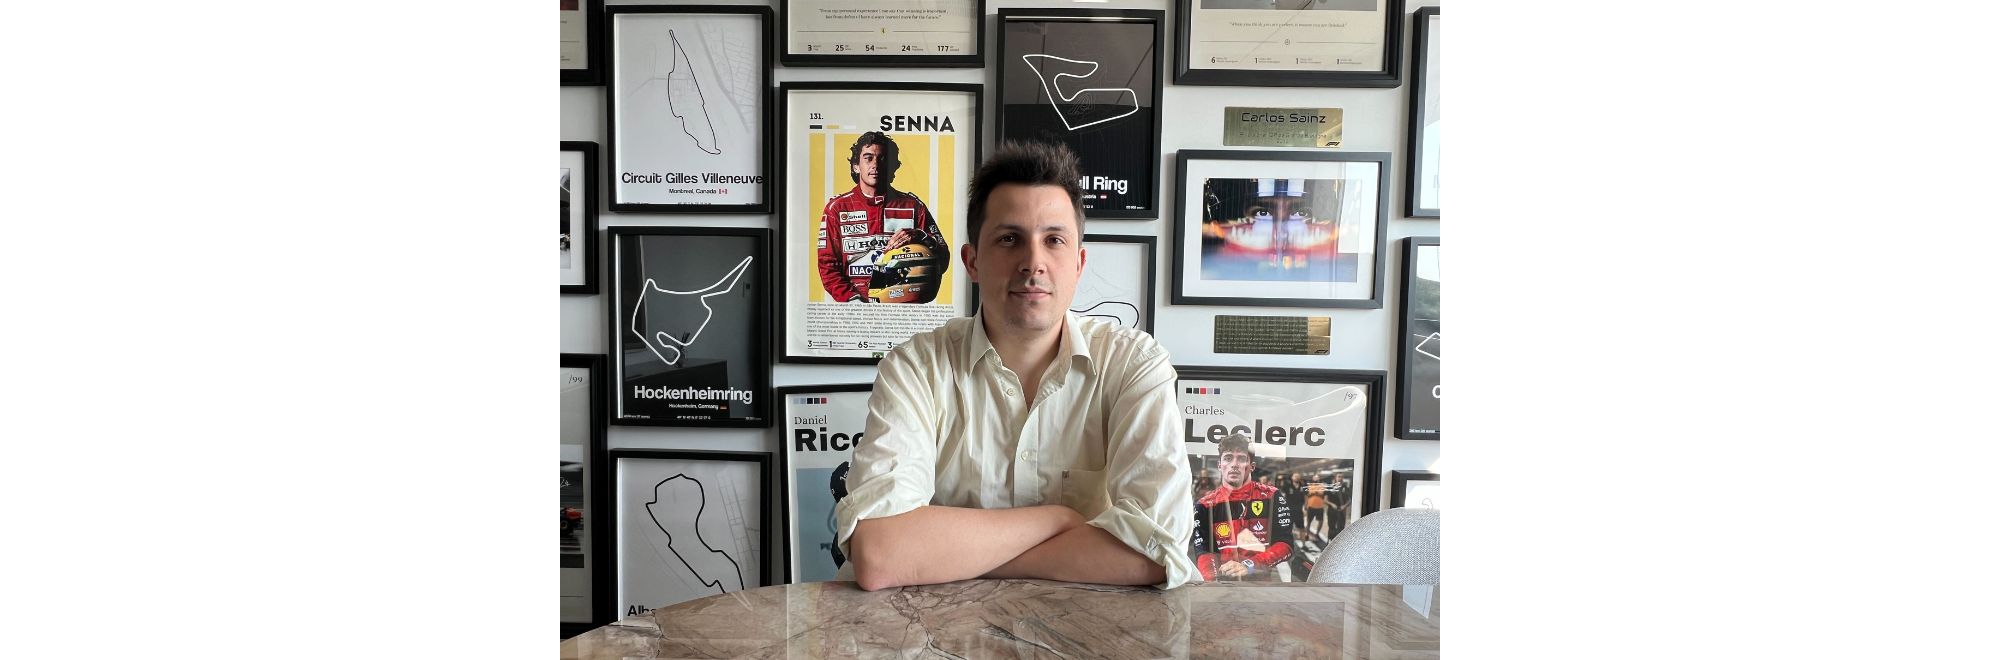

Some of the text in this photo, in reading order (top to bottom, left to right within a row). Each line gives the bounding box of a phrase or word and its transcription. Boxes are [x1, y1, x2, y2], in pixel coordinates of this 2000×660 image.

[1242, 112, 1326, 124] Carlos Sainz
[880, 115, 955, 133] SENNA
[621, 172, 764, 184] Circuit Gilles Villeneuve
[1093, 176, 1128, 194] Ring
[843, 224, 867, 233] BOSS
[859, 239, 889, 249] HON
[829, 340, 833, 348] 1
[857, 341, 869, 349] 65
[887, 341, 893, 349] 3
[634, 385, 753, 404] Hockenheimring
[1184, 406, 1225, 415] Charles
[794, 415, 828, 425] Daniel
[1184, 418, 1326, 447] Leclerc
